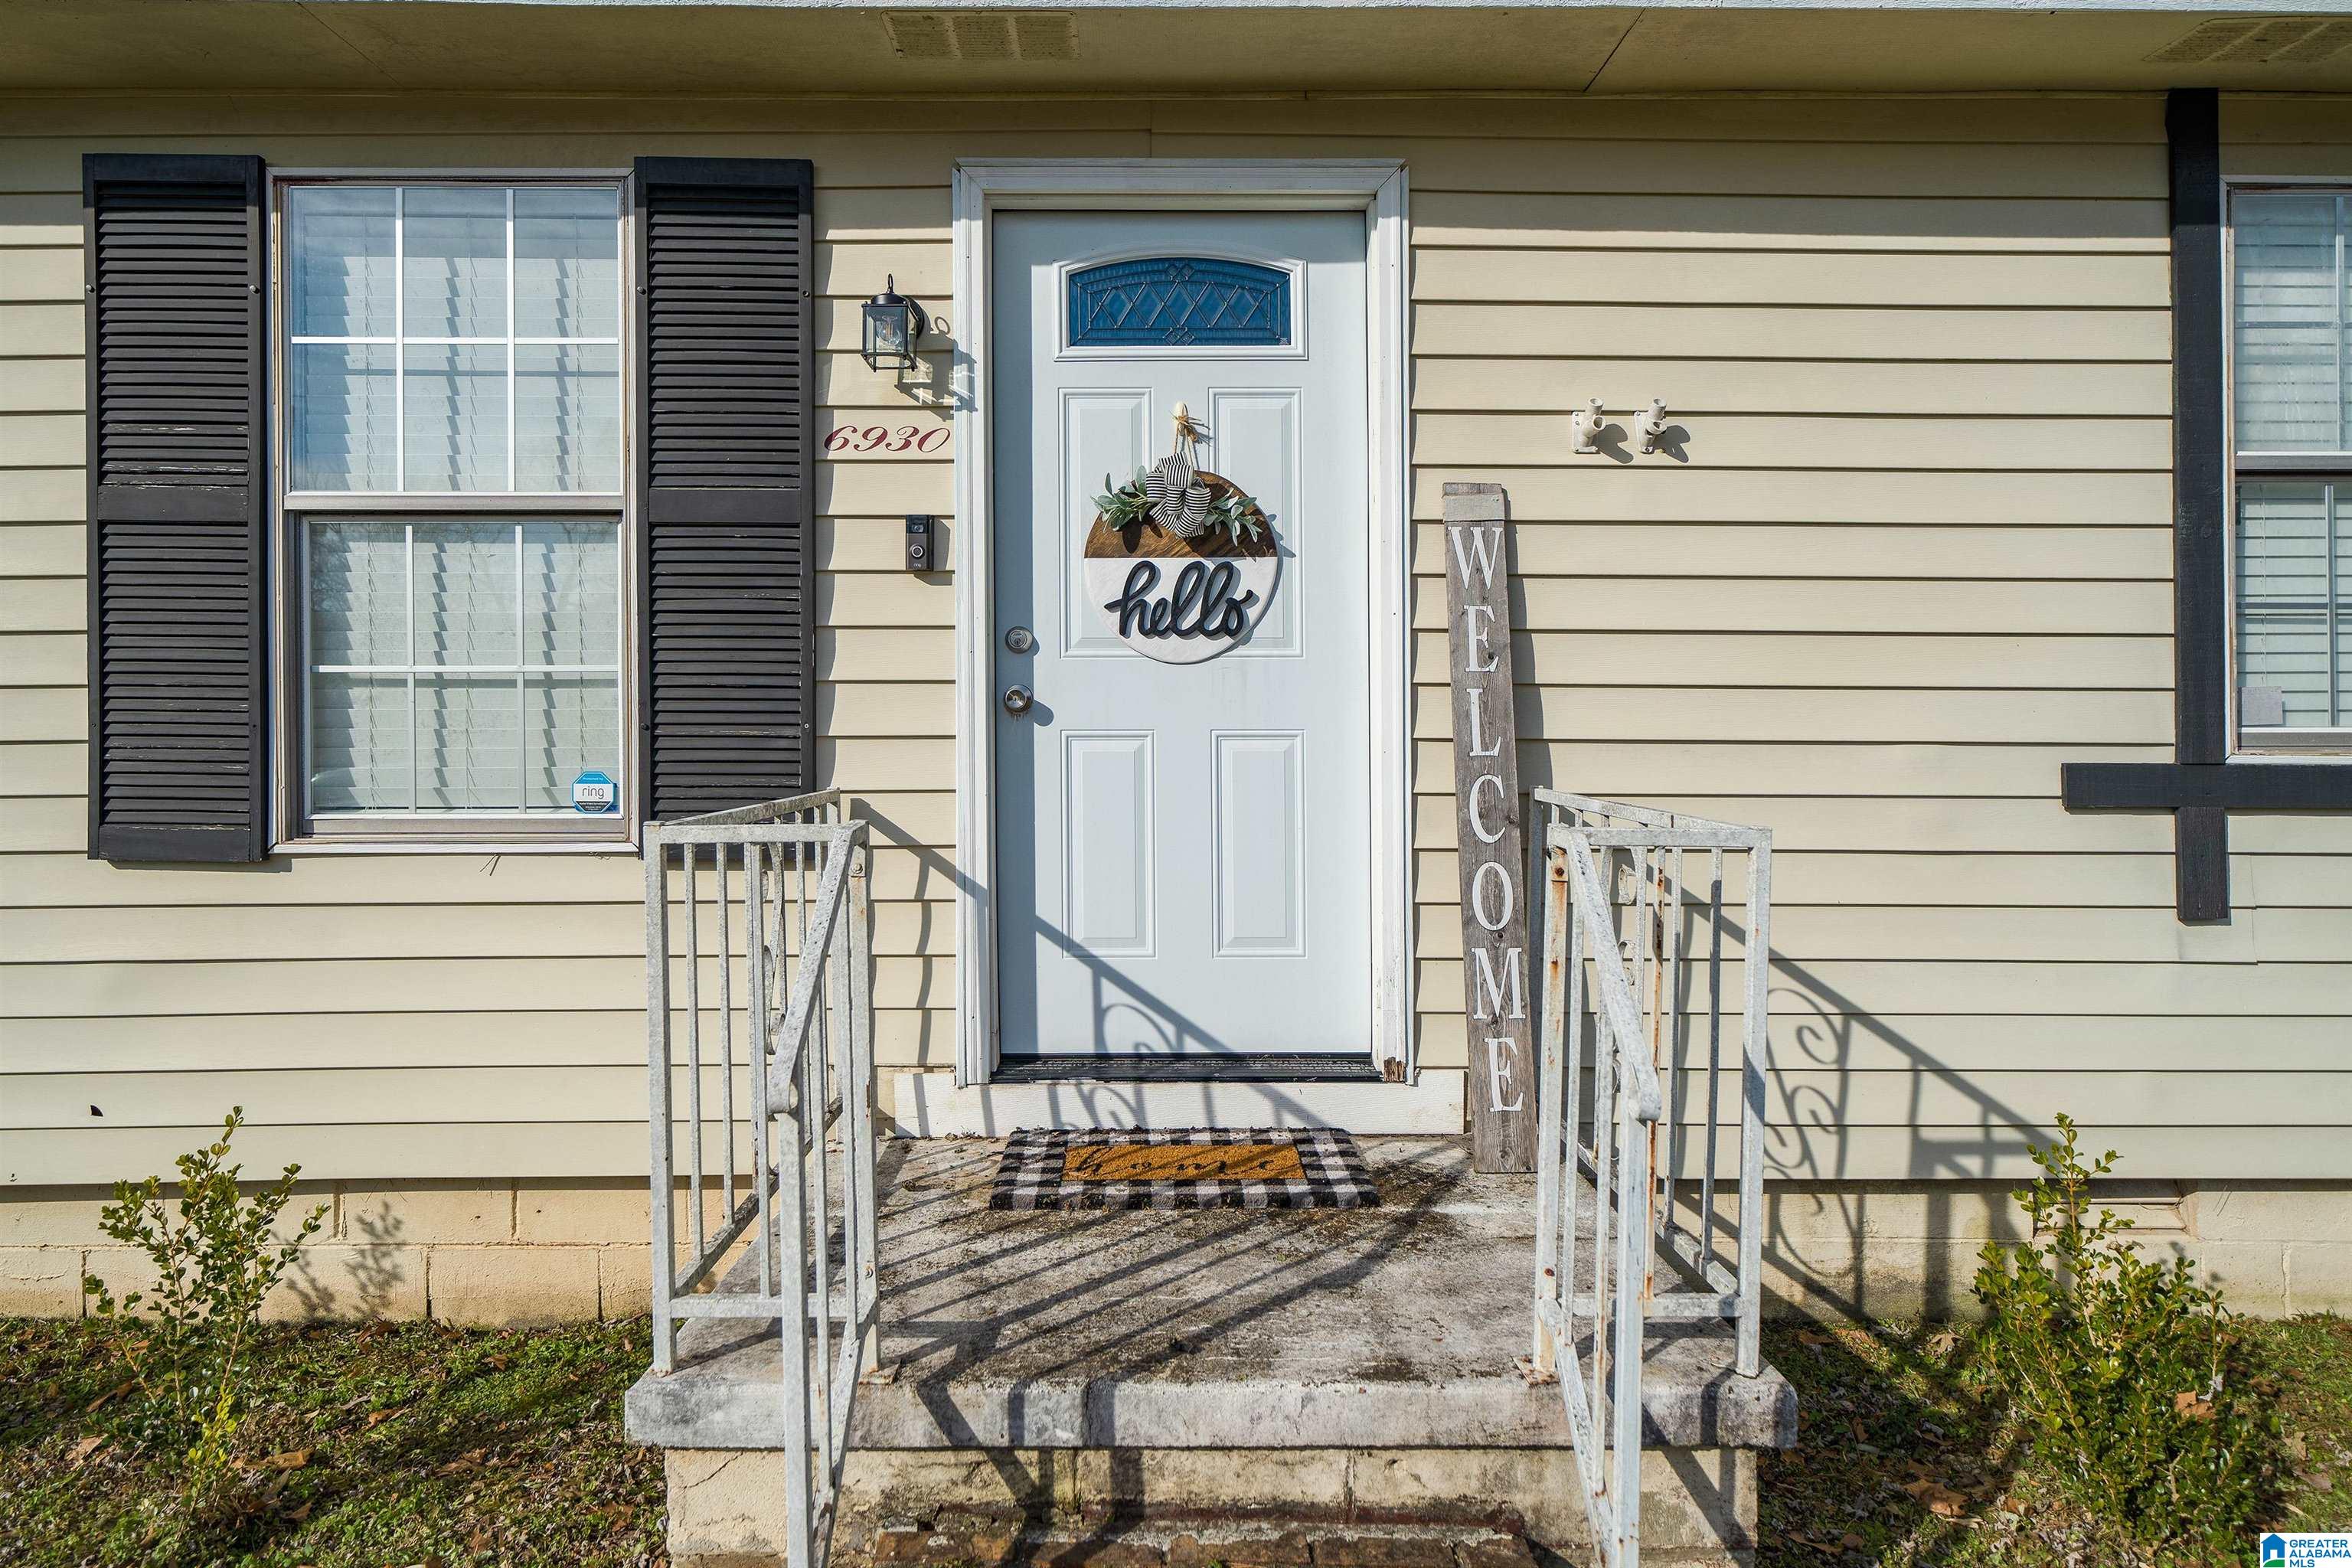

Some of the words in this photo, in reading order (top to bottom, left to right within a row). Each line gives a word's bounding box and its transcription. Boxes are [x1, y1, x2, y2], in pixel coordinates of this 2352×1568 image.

[824, 425, 951, 453] 6930
[1103, 560, 1254, 637] hello
[582, 786, 604, 799] ring
[1447, 526, 1526, 1112] WELCOME
